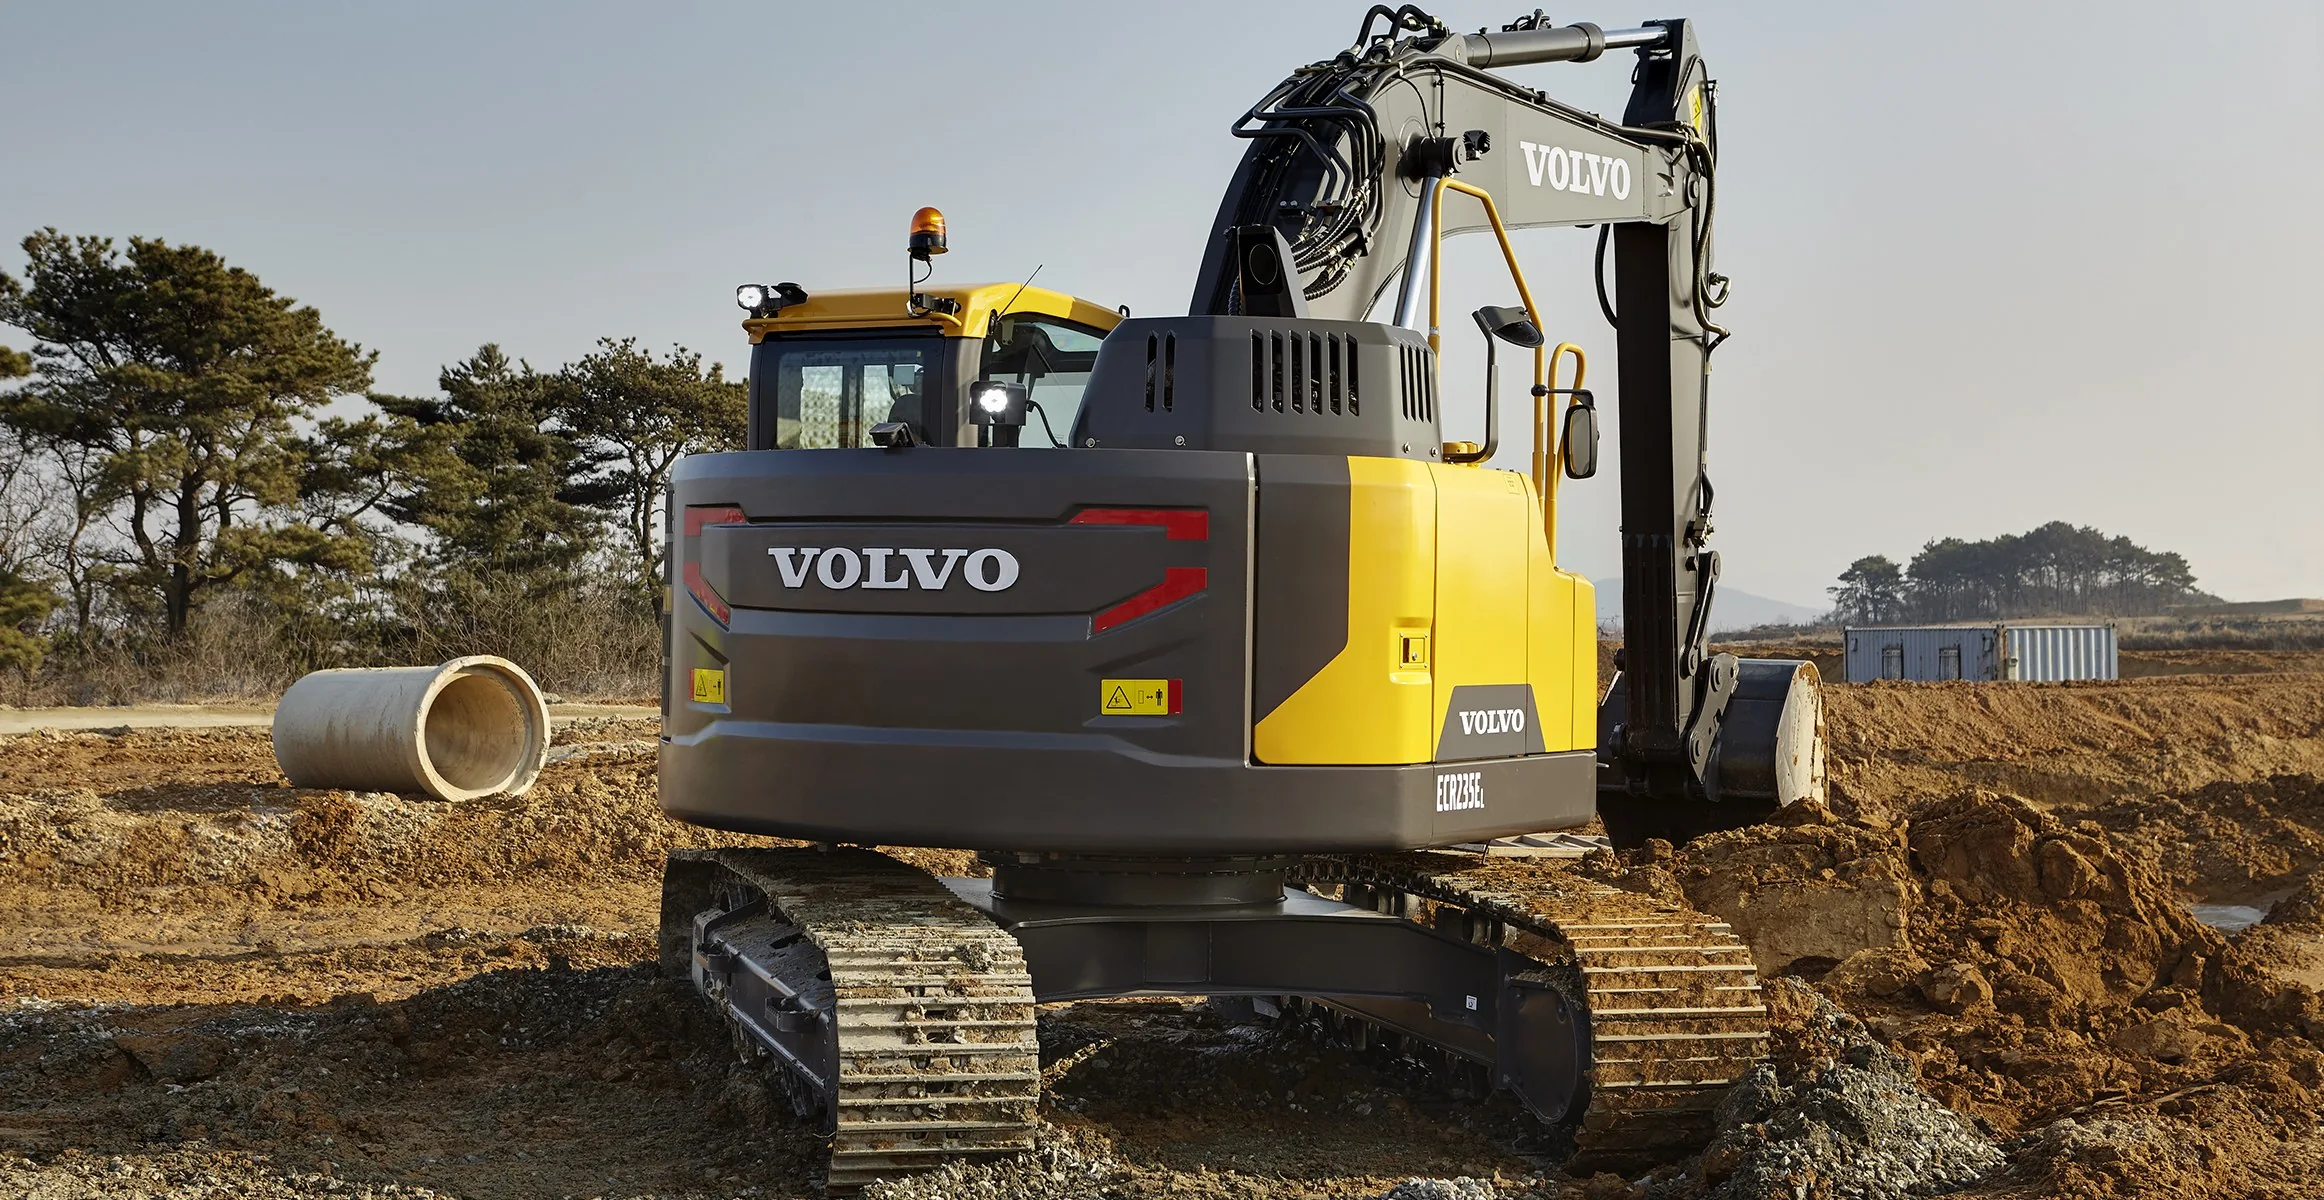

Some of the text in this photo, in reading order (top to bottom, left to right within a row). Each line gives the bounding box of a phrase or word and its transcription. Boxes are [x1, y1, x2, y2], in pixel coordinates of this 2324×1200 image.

[1520, 141, 1631, 200] VOLVO
[768, 547, 1020, 592] VOLVO
[1459, 708, 1525, 735] VOLVO
